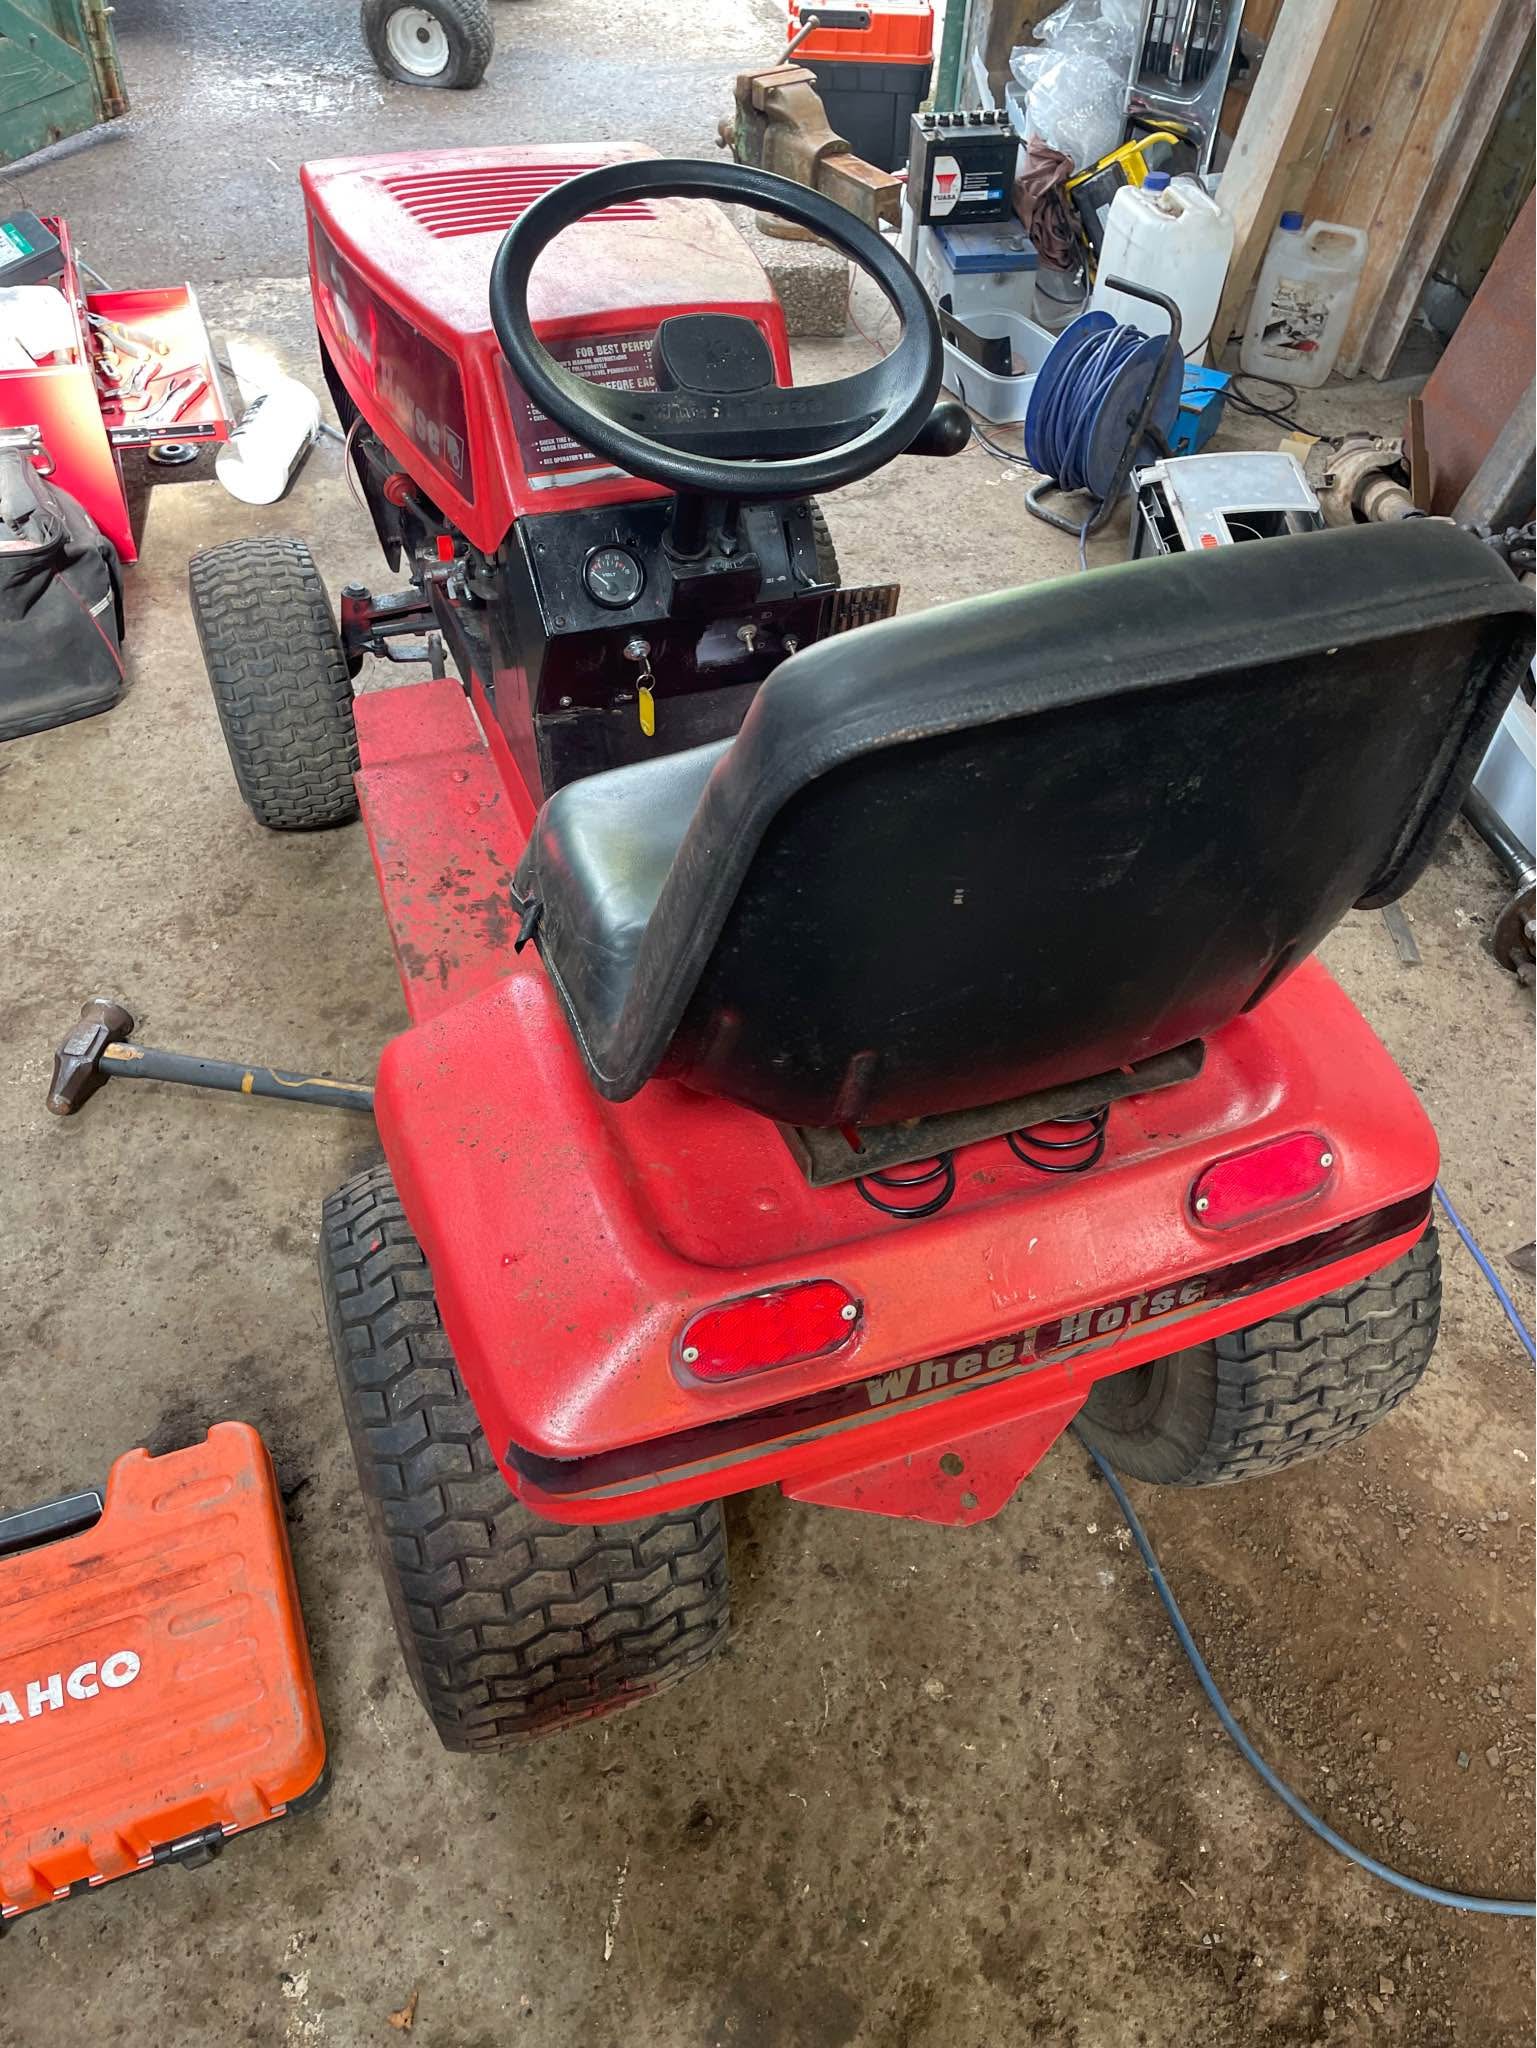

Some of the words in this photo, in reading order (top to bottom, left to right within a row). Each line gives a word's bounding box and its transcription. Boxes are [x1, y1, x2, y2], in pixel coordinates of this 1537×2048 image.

[576, 347, 594, 358] FOR
[596, 343, 620, 356] BEST
[637, 376, 656, 387] EAC
[866, 1326, 1041, 1406] Wheel
[1056, 1279, 1208, 1347] Horse
[0, 1650, 141, 1725] AHCO
